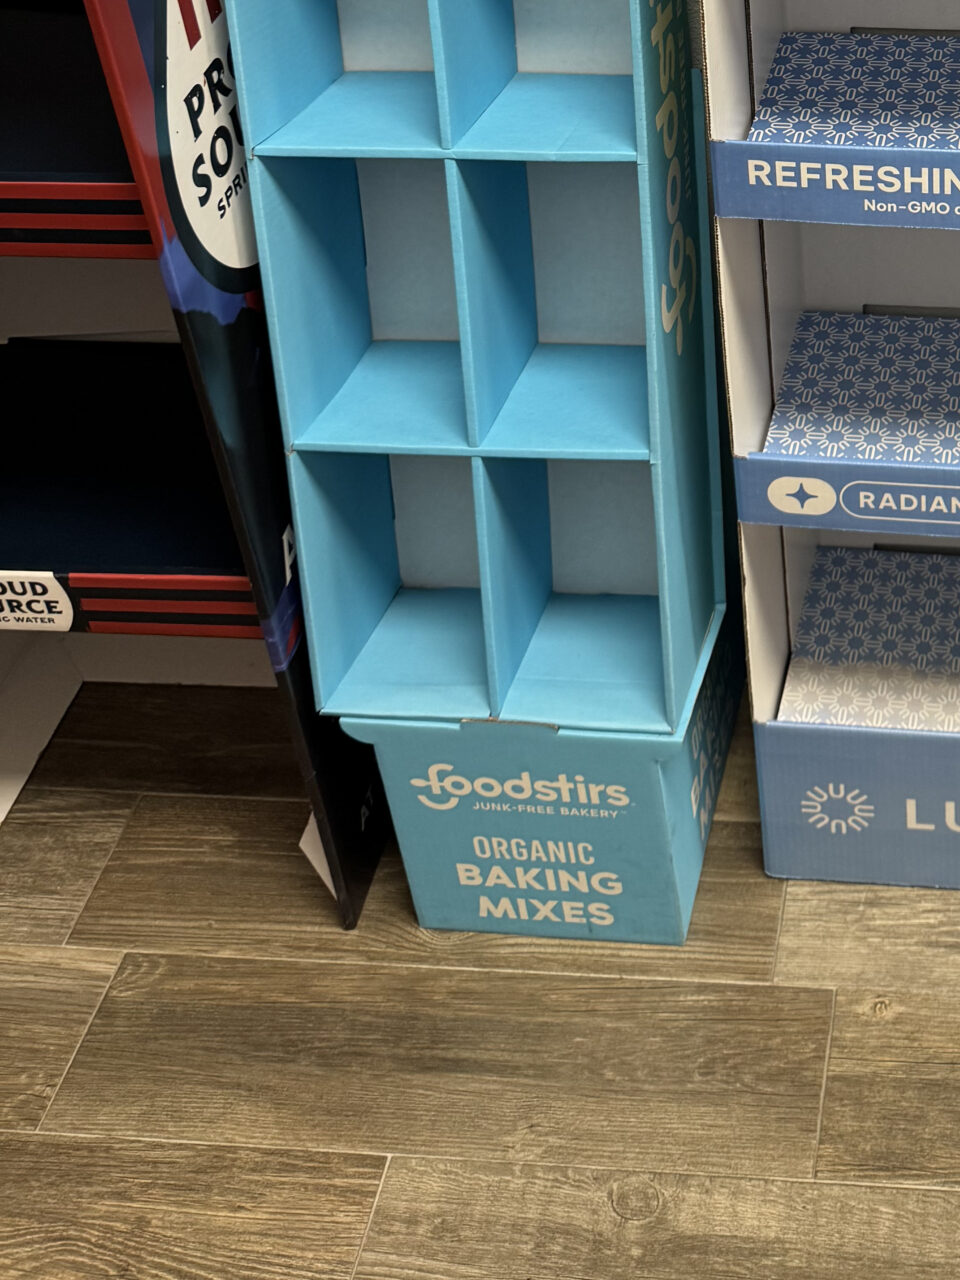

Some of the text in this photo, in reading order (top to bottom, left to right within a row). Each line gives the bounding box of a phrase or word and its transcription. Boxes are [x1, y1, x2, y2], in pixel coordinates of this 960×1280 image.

[863, 198, 951, 216] Non-GMO
[14, 616, 56, 624] WATER
[473, 801, 555, 815] JUNK-FREE
[472, 835, 596, 866] ORGANIC
[455, 862, 624, 896] BAKING
[478, 895, 615, 926] MIXES
